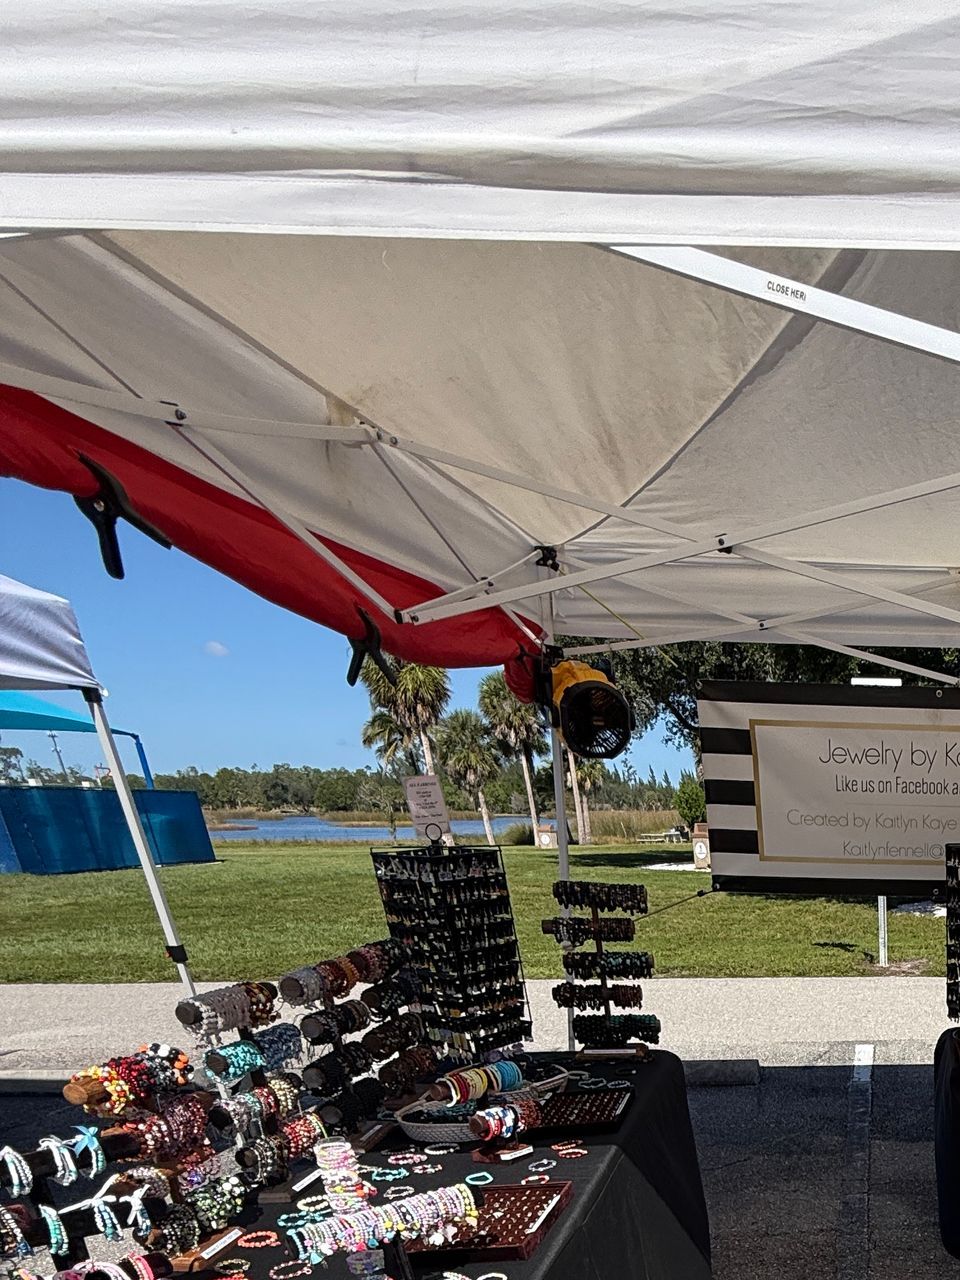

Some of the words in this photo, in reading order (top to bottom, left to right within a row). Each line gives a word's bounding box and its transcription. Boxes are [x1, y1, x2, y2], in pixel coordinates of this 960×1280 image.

[767, 281, 790, 296] CLOSE
[819, 738, 903, 773] Jewelry
[910, 741, 938, 774] by
[835, 774, 859, 793] Like
[861, 779, 875, 793] us
[878, 780, 892, 794] on
[895, 776, 950, 796] Facebook
[786, 808, 849, 827] Created
[853, 812, 871, 832] by
[875, 812, 918, 833] Kaitlyn
[922, 813, 958, 834] Kaye
[843, 840, 945, 860] Kaitlynfennell@
